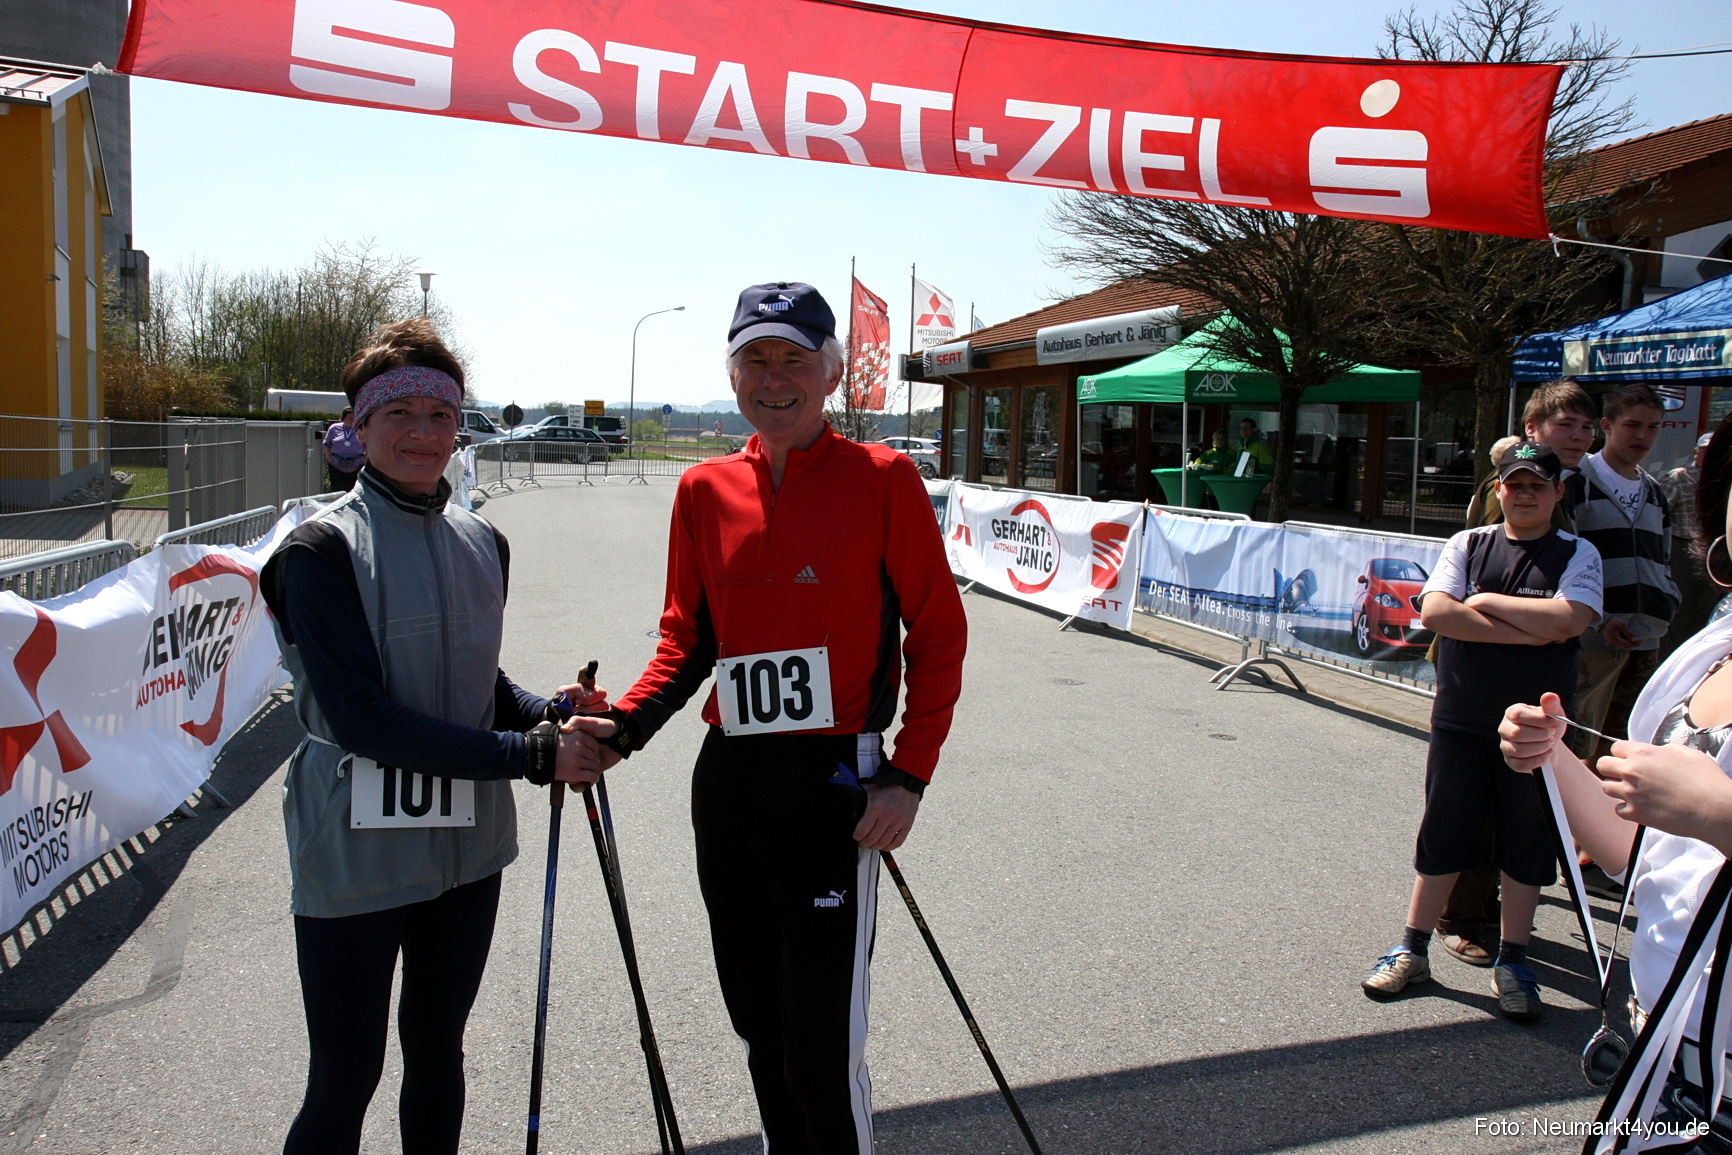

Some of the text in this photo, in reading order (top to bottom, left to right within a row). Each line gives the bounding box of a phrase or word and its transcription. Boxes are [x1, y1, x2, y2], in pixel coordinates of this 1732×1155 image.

[758, 301, 789, 312] PUMA
[857, 305, 880, 316] SEA
[916, 328, 955, 337] MITSUBISHI
[1042, 325, 1166, 353] Autohaus Gerhart & Jänig
[936, 351, 963, 366] SEAT
[1595, 343, 1717, 366] Neumarkter Tagblatt
[1194, 373, 1237, 392] AOK
[1661, 421, 1691, 429] AT
[991, 518, 1046, 548] GERHART
[993, 541, 1018, 555] AUTOHAUS
[1016, 545, 1052, 573] JÄNIG
[1149, 580, 1167, 599] Der
[1194, 593, 1226, 616] Altea.
[1227, 604, 1251, 622] Cross
[1255, 613, 1270, 627] the
[1516, 587, 1545, 597] Allianz
[231, 602, 245, 626] &
[729, 655, 814, 725] 103
[376, 760, 452, 817] 101
[0, 790, 93, 868] MITSUBISHI
[13, 830, 69, 899] MOTORS
[814, 897, 840, 908] PUMA
[900, 885, 927, 931] SWIX
